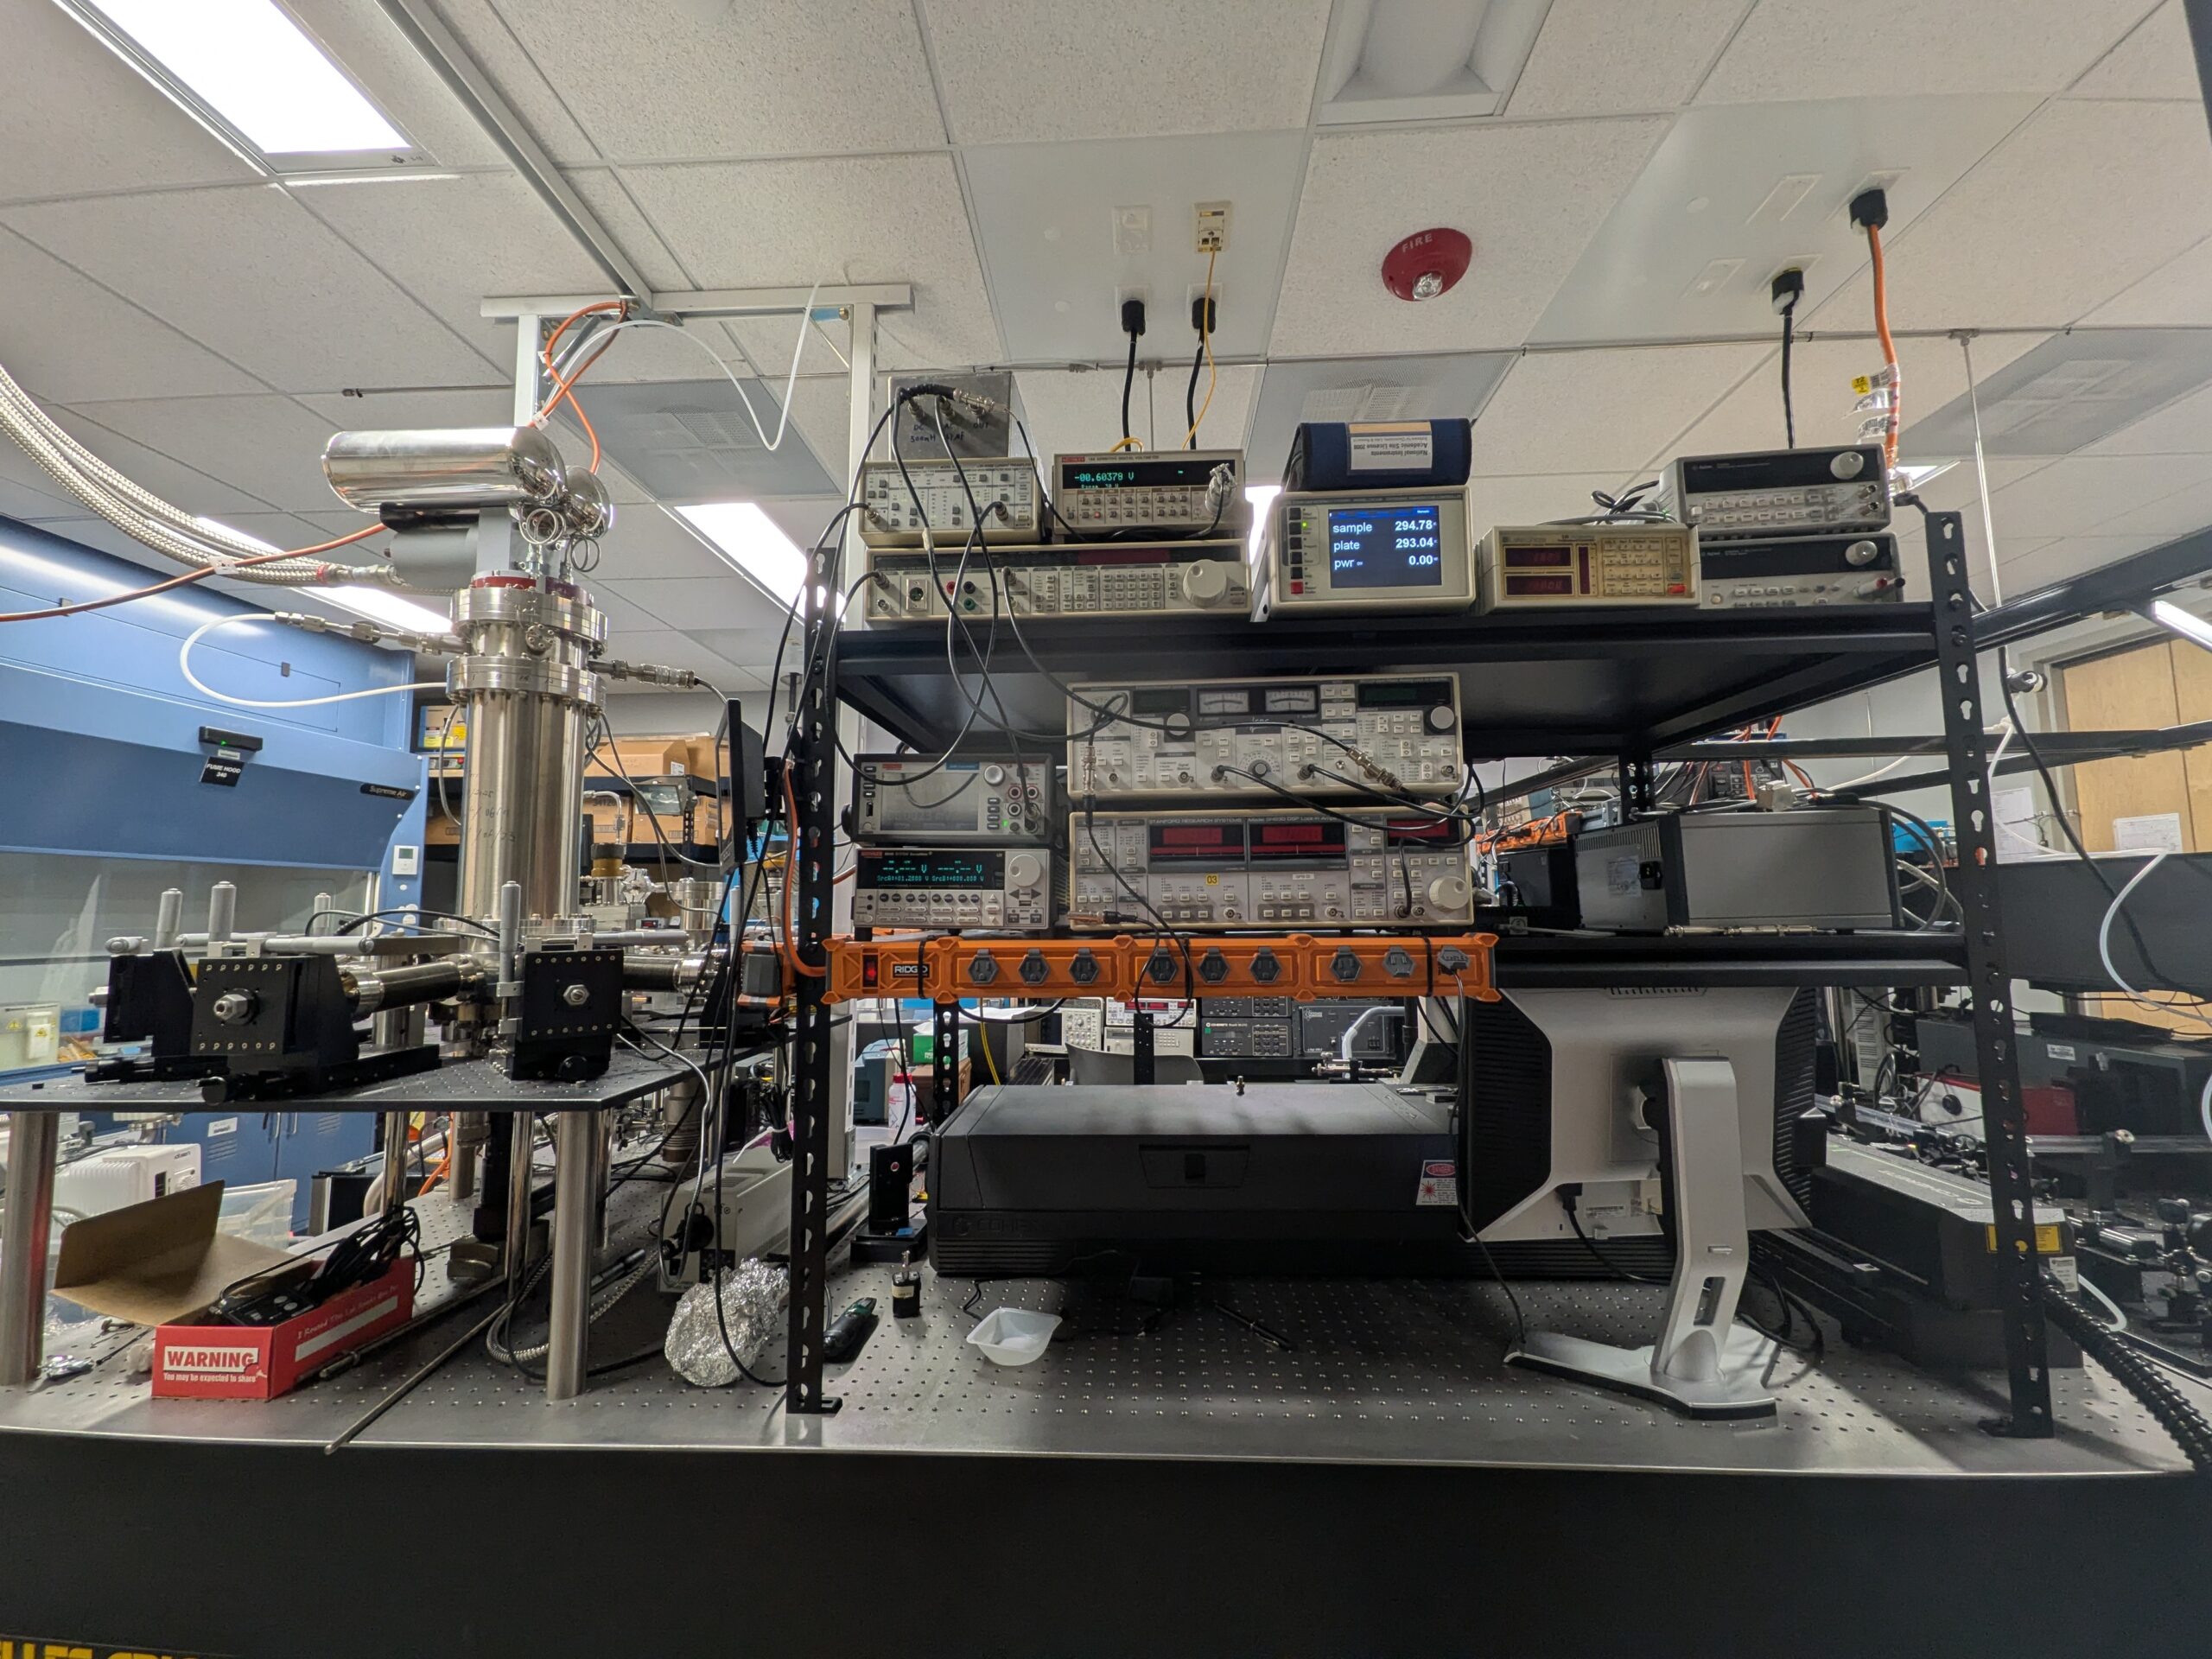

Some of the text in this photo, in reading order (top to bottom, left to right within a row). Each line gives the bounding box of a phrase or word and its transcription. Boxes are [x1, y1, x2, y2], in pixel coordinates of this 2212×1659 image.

[1402, 233, 1433, 252] FIRE
[1128, 472, 1134, 480] V
[1332, 522, 1372, 535] sample
[1395, 520, 1433, 531] 294.78
[1333, 540, 1360, 553] plate
[1395, 537, 1433, 549] 293.04
[1334, 559, 1355, 570] pwr
[1408, 555, 1433, 565] 0.00
[369, 785, 397, 796] Supreme
[1206, 875, 1217, 884] 03
[167, 1351, 254, 1367] WARNING
